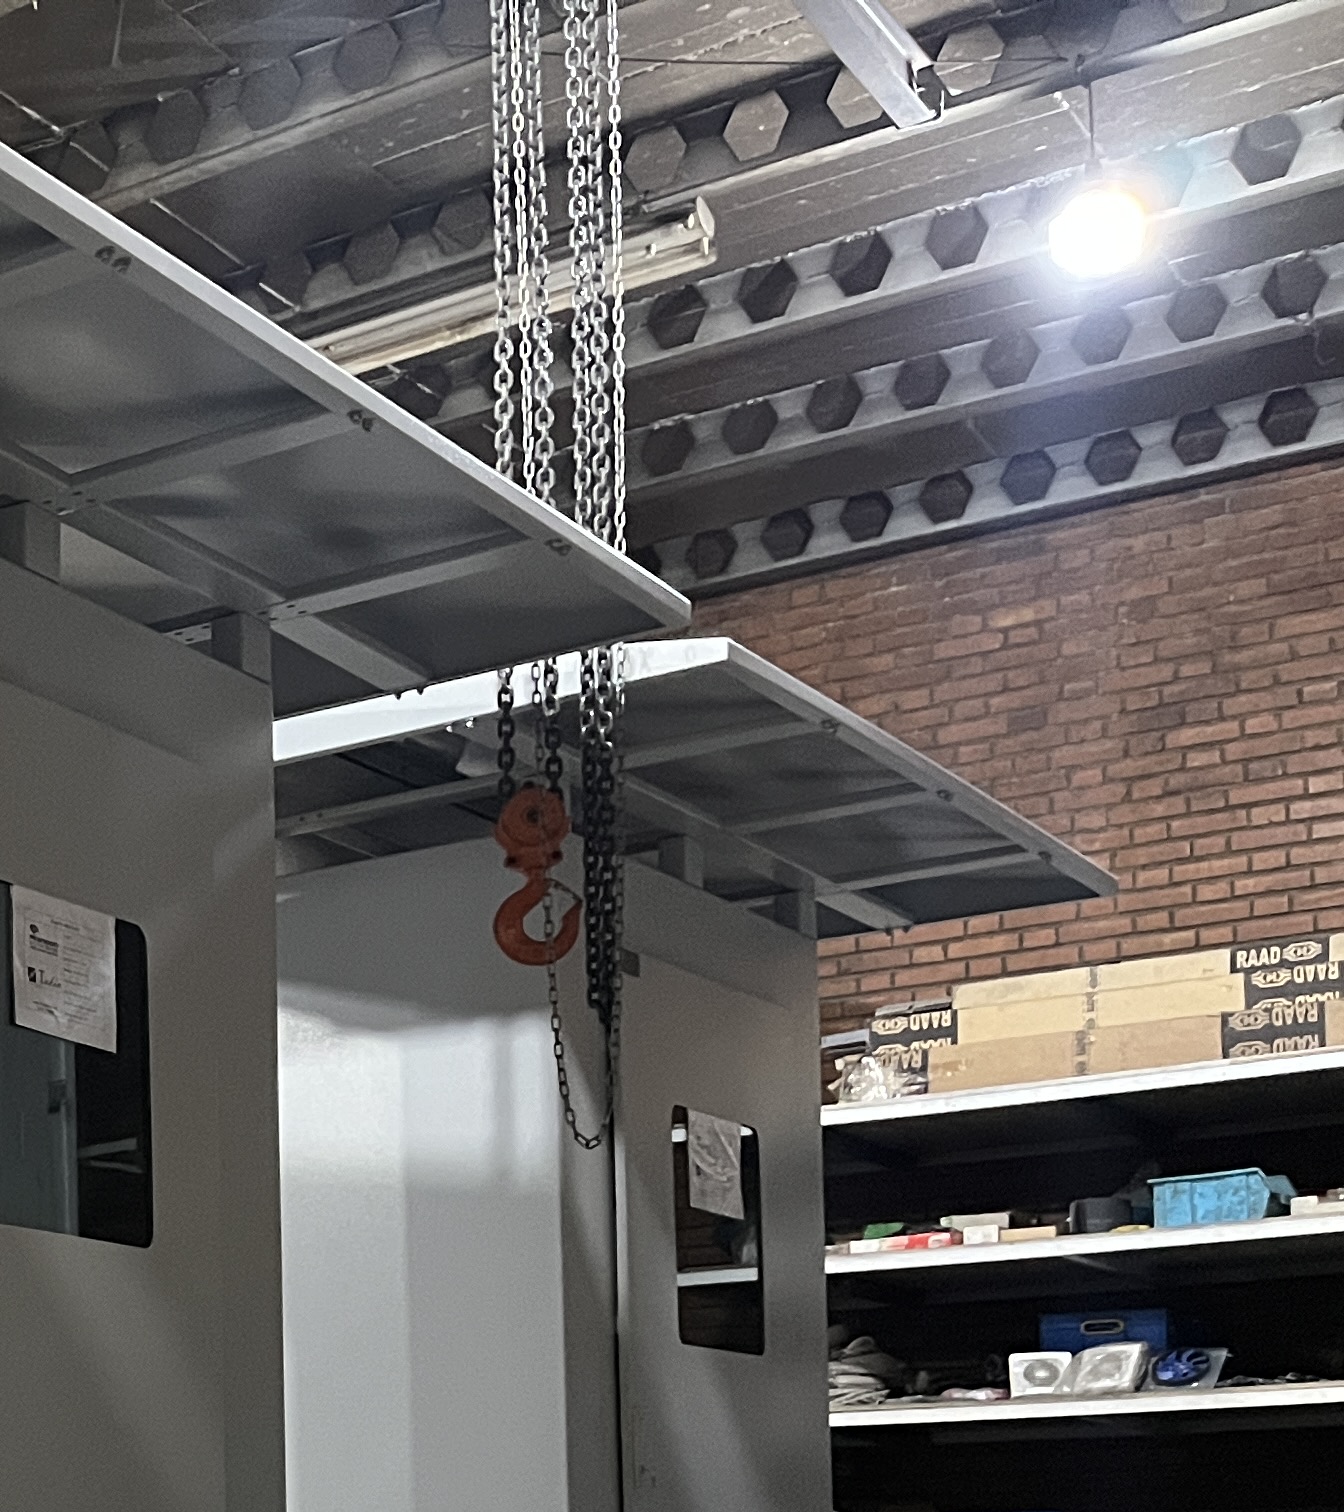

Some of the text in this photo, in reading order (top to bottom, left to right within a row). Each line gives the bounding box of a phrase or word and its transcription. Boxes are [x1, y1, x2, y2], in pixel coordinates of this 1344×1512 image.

[1236, 946, 1281, 969] RAAD
[1293, 961, 1339, 984] RAAD
[909, 1009, 952, 1031] RAAD
[1272, 1003, 1318, 1026] RAAD
